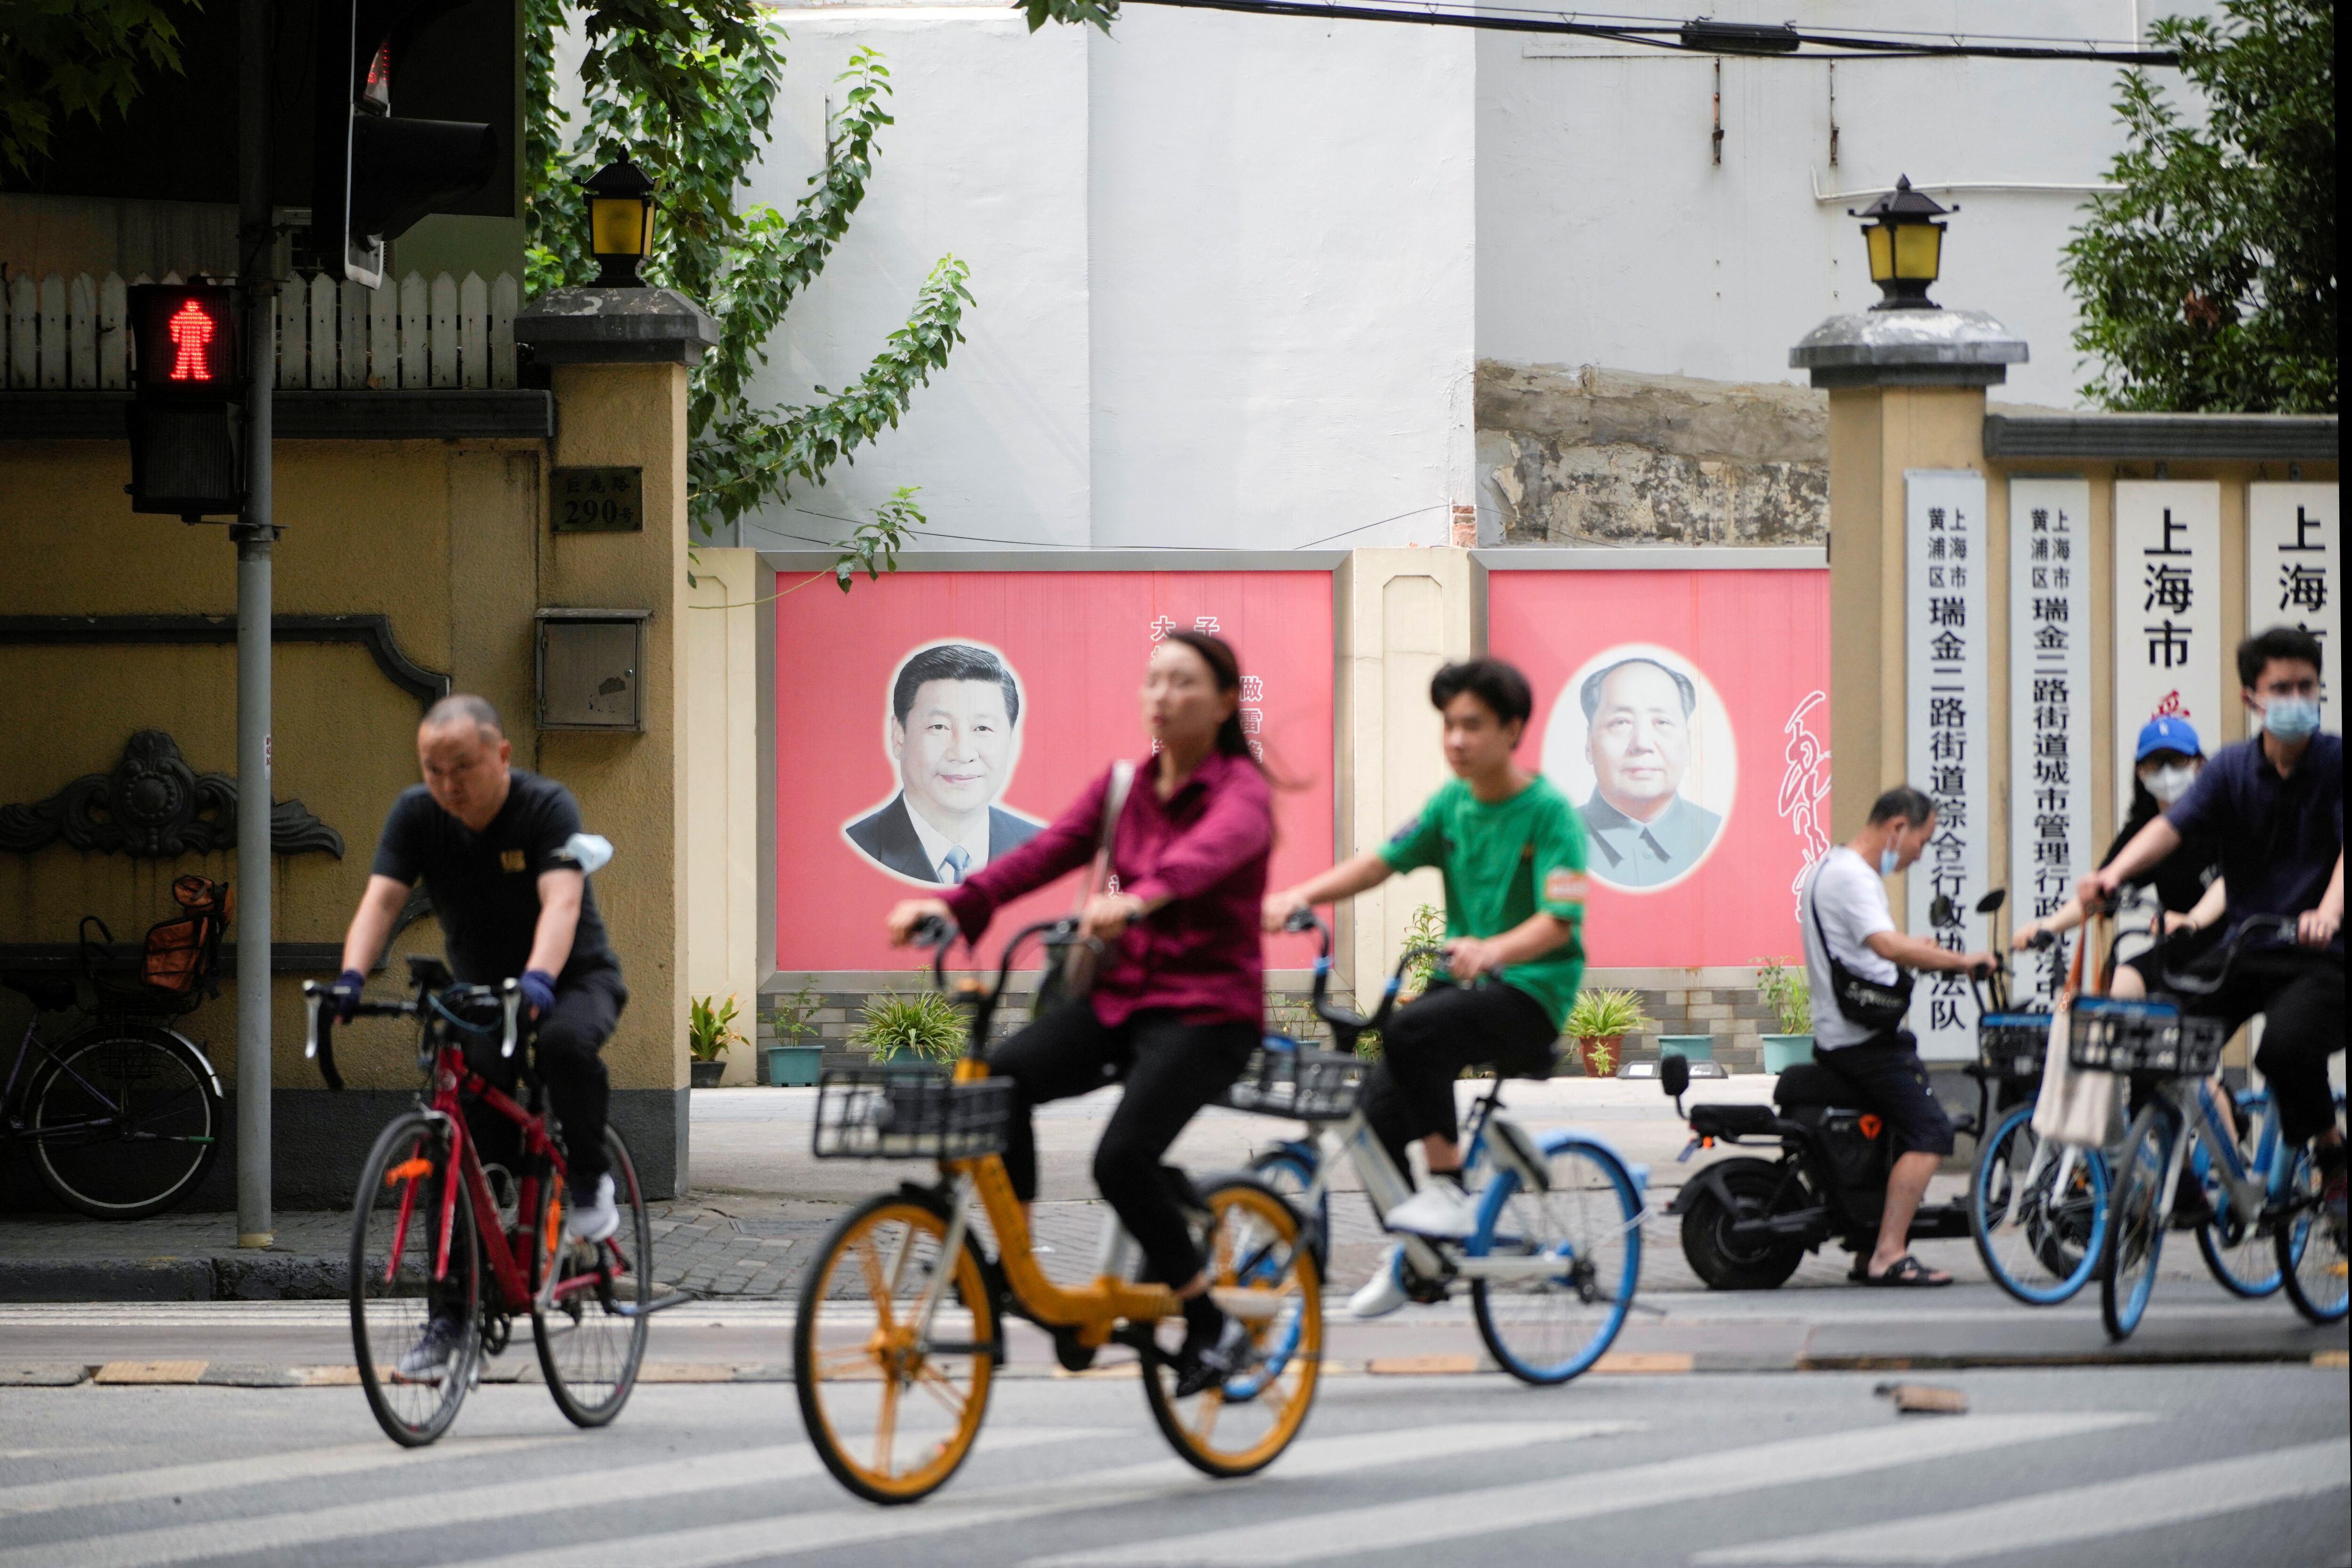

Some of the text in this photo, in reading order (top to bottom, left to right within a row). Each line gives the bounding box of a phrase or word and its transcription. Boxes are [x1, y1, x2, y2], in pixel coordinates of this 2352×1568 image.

[564, 499, 634, 524] 290号
[566, 474, 631, 493] 巨鹿路
[1928, 507, 1946, 588] 黄浦区
[1949, 508, 1967, 590] 上海市
[2030, 508, 2049, 589] 黄浦区
[2052, 508, 2070, 590] 上海市
[2143, 507, 2193, 669] 上海市
